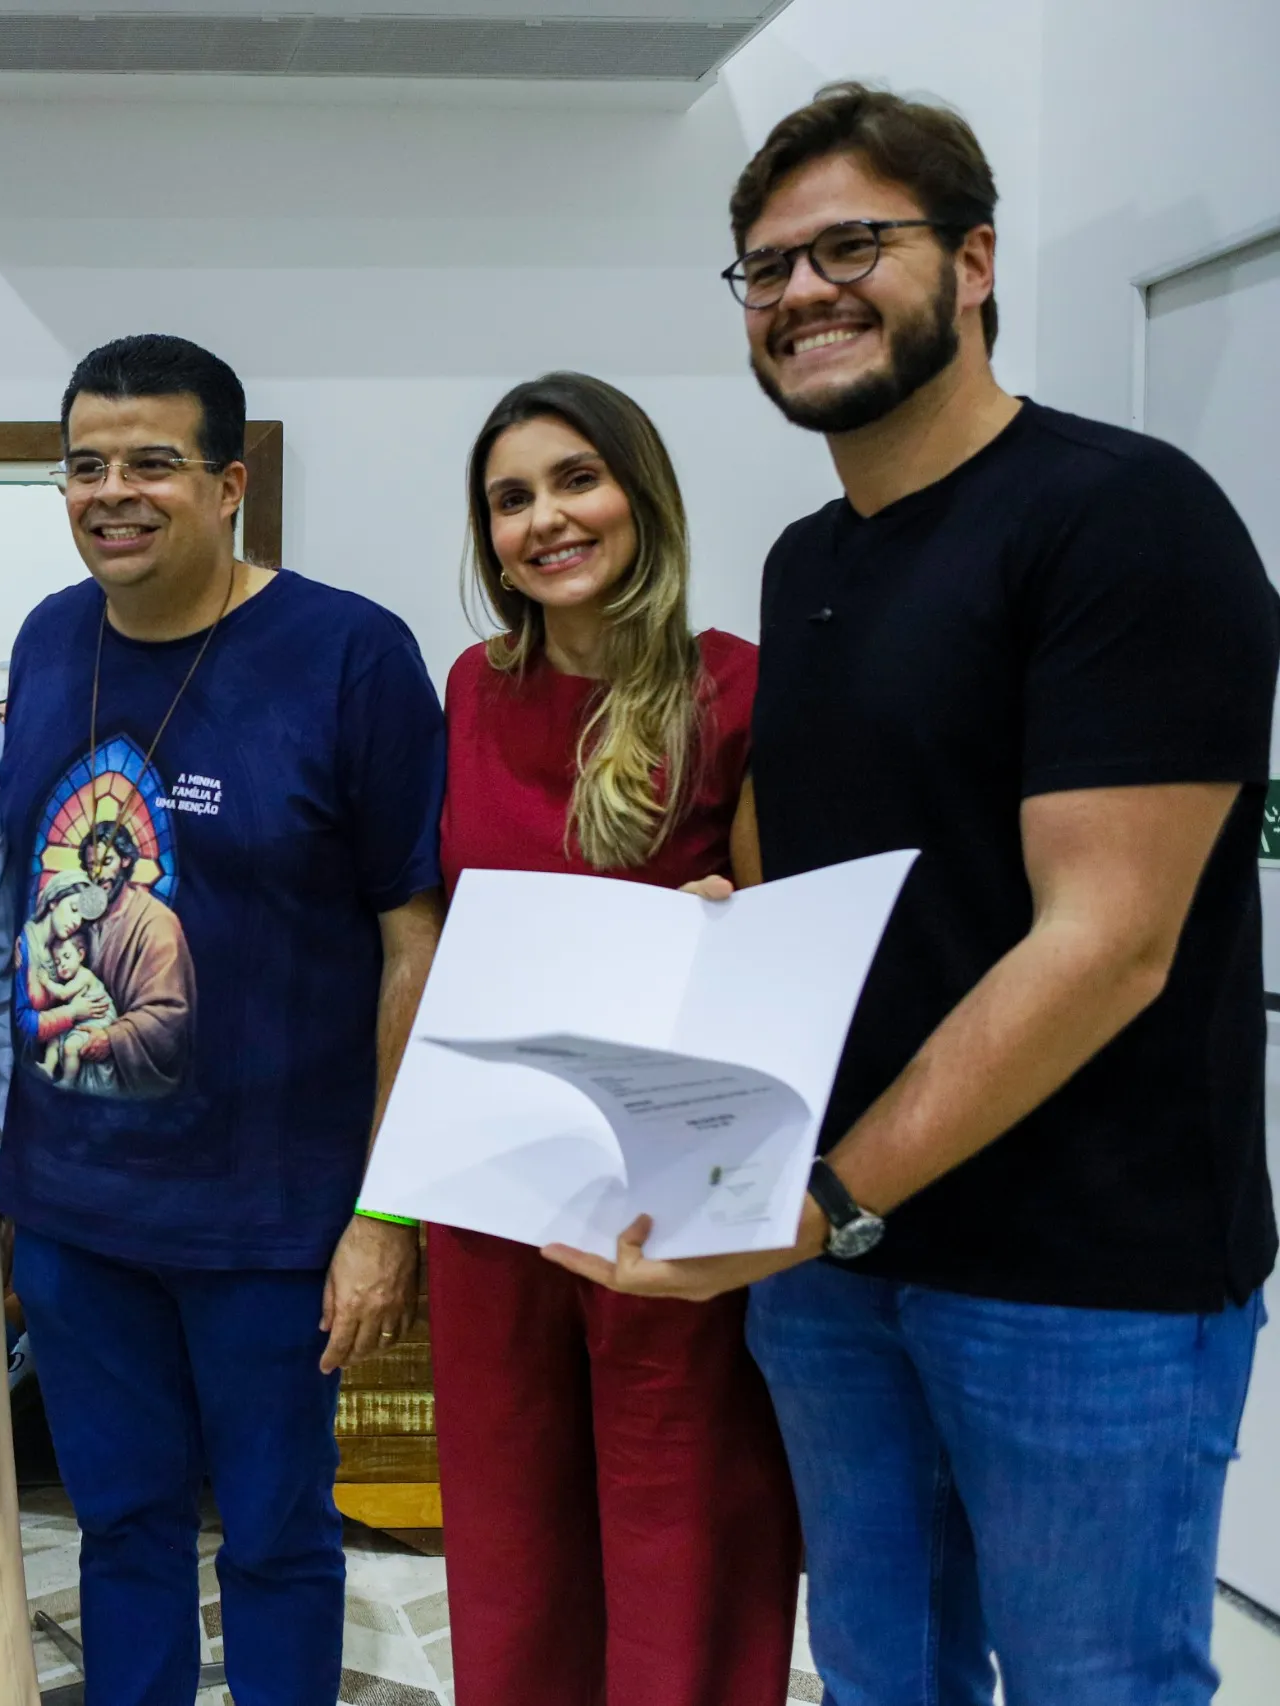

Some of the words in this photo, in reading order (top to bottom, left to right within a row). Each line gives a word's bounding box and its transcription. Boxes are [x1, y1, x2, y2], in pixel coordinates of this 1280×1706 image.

[178, 773, 186, 783] A
[187, 774, 221, 789] MINHA
[172, 785, 211, 800] FAMÍLIA
[213, 790, 222, 802] É
[155, 796, 176, 809] UMA
[177, 800, 219, 816] BENÇÃO
